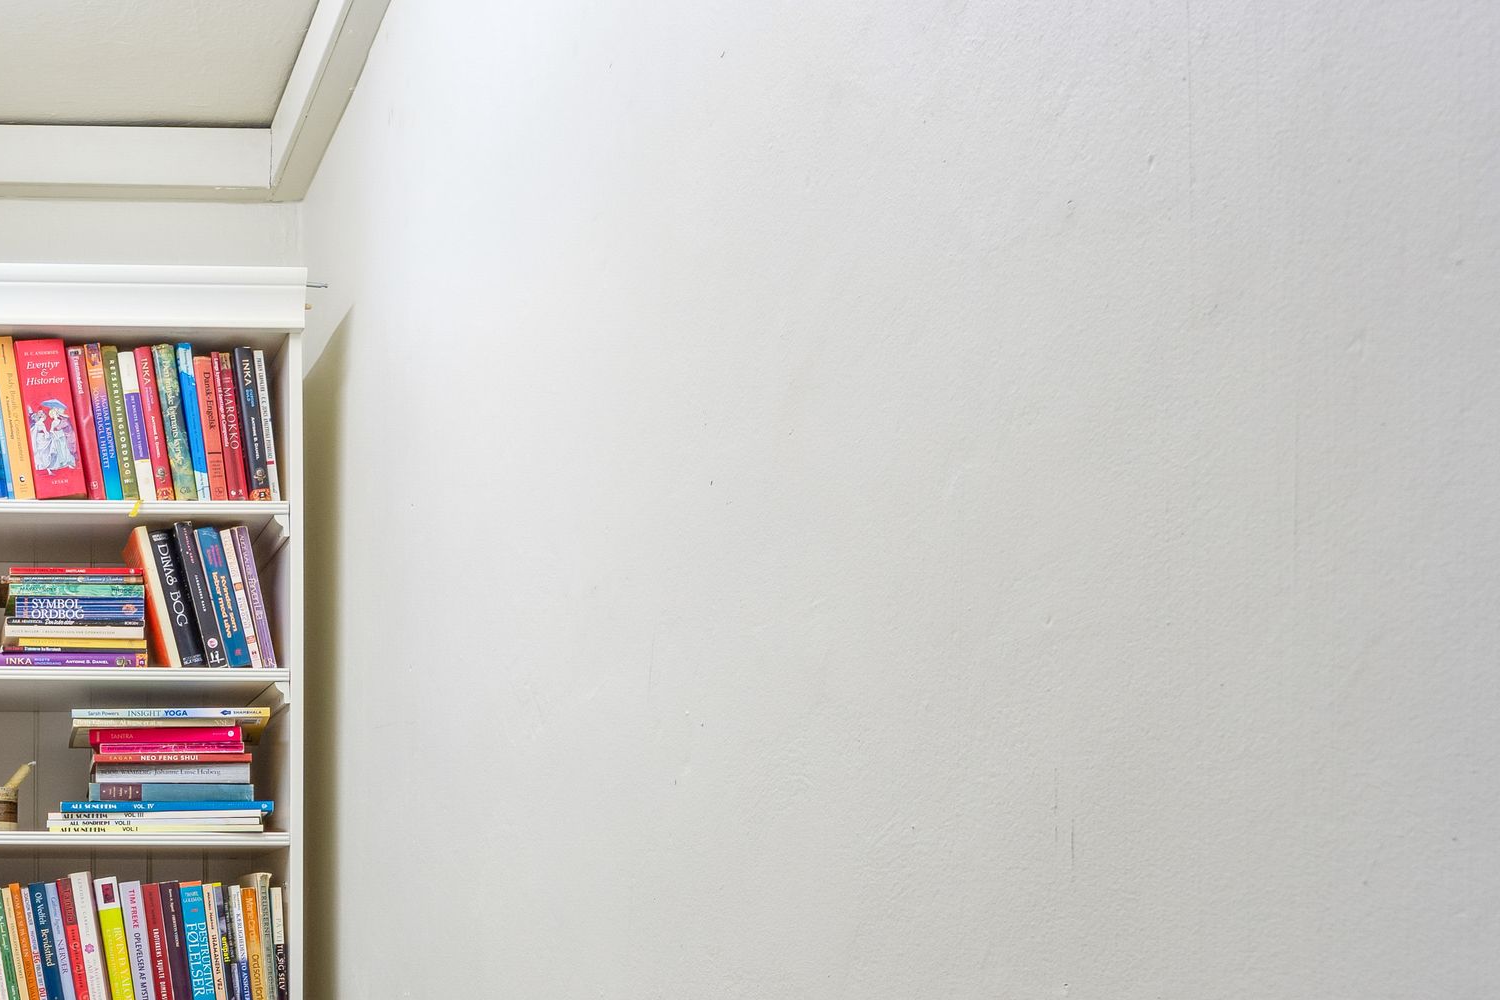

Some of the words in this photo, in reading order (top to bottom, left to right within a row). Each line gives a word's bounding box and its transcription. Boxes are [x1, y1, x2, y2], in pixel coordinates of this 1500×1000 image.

[26, 361, 60, 370] Eventyr
[73, 356, 84, 394] Fremmedord
[141, 358, 151, 385] INKA
[242, 359, 251, 386] INKA
[25, 377, 65, 386] Historier
[100, 395, 109, 421] JAGUAR
[203, 371, 215, 431] Dansk-Engelsk
[109, 359, 131, 476] RETSKRIVNINGSORDBOG
[224, 387, 239, 449] MAROKKO
[99, 440, 109, 469] HJERTET
[104, 428, 115, 459] KROPPEN
[157, 543, 177, 586] DINAS
[169, 591, 188, 627] BOG
[31, 599, 82, 609] SYMBOL
[31, 609, 84, 619] ORDBOG
[218, 598, 227, 618] med
[34, 892, 42, 902] Ole
[128, 889, 136, 906] TIM
[36, 903, 47, 925] Vedfelt
[130, 906, 140, 929] FREKE
[40, 928, 55, 967] Bevidsthed
[133, 932, 145, 971] OPLEVELSEN
[185, 923, 204, 997] FØLELSER
[197, 922, 215, 995] DESTRUKTIVE
[221, 936, 231, 963] empati
[139, 972, 146, 981] AF
[276, 956, 284, 971] SIG
